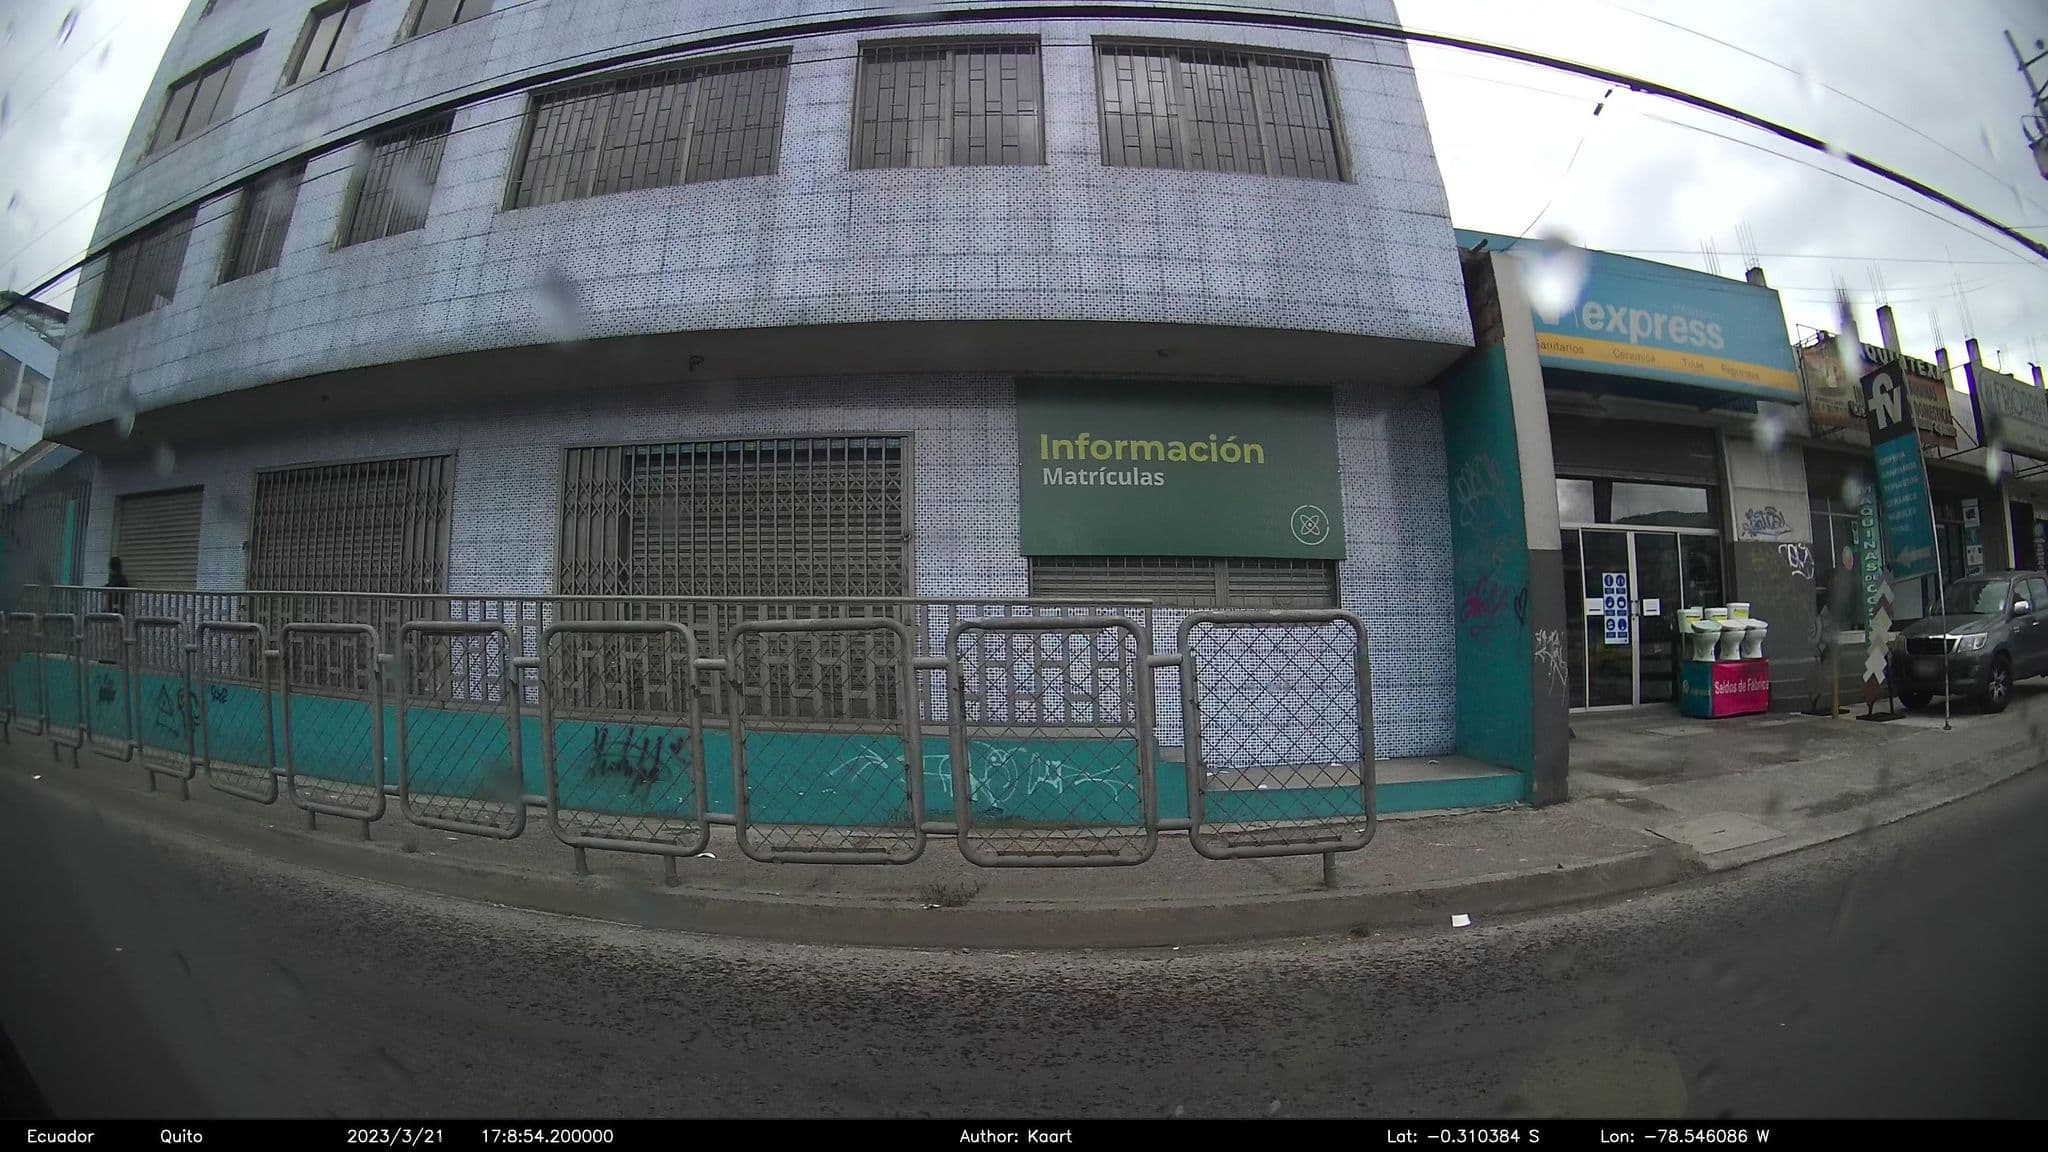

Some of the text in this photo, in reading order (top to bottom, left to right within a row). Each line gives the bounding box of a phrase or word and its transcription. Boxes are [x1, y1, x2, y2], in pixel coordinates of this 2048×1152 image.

[1581, 300, 1725, 350] express
[1040, 432, 1265, 464] Información
[1042, 466, 1165, 486] Matrículas
[1713, 680, 1737, 695] Saldos
[1738, 679, 1746, 693] de
